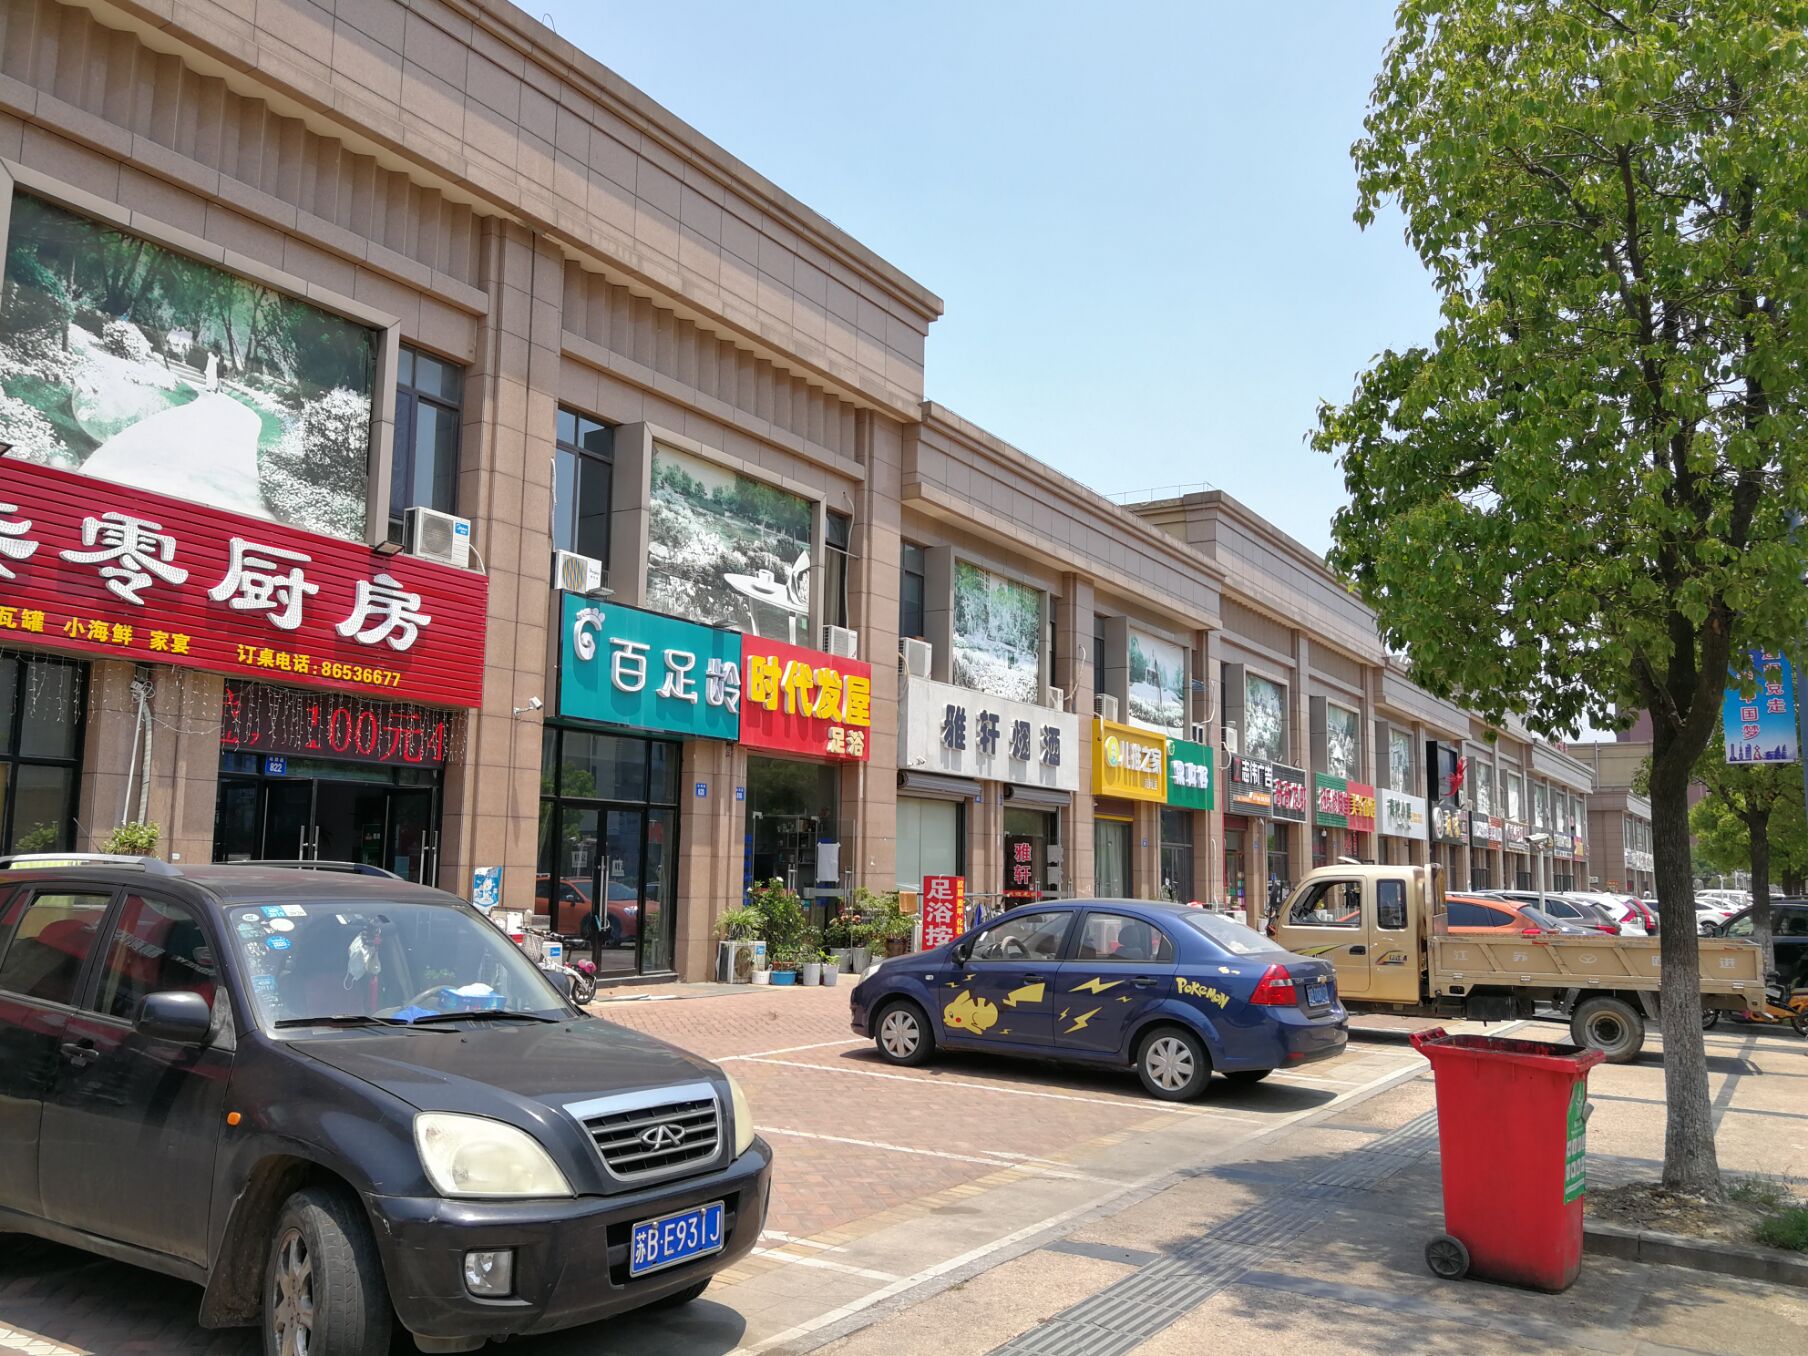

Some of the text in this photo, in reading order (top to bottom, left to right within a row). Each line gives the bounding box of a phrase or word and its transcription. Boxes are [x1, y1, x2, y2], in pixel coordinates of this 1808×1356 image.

[64, 617, 133, 645] 小海鲜
[150, 630, 191, 655] 家宴
[747, 655, 871, 727] 时代发屋
[827, 726, 865, 756] 足浴
